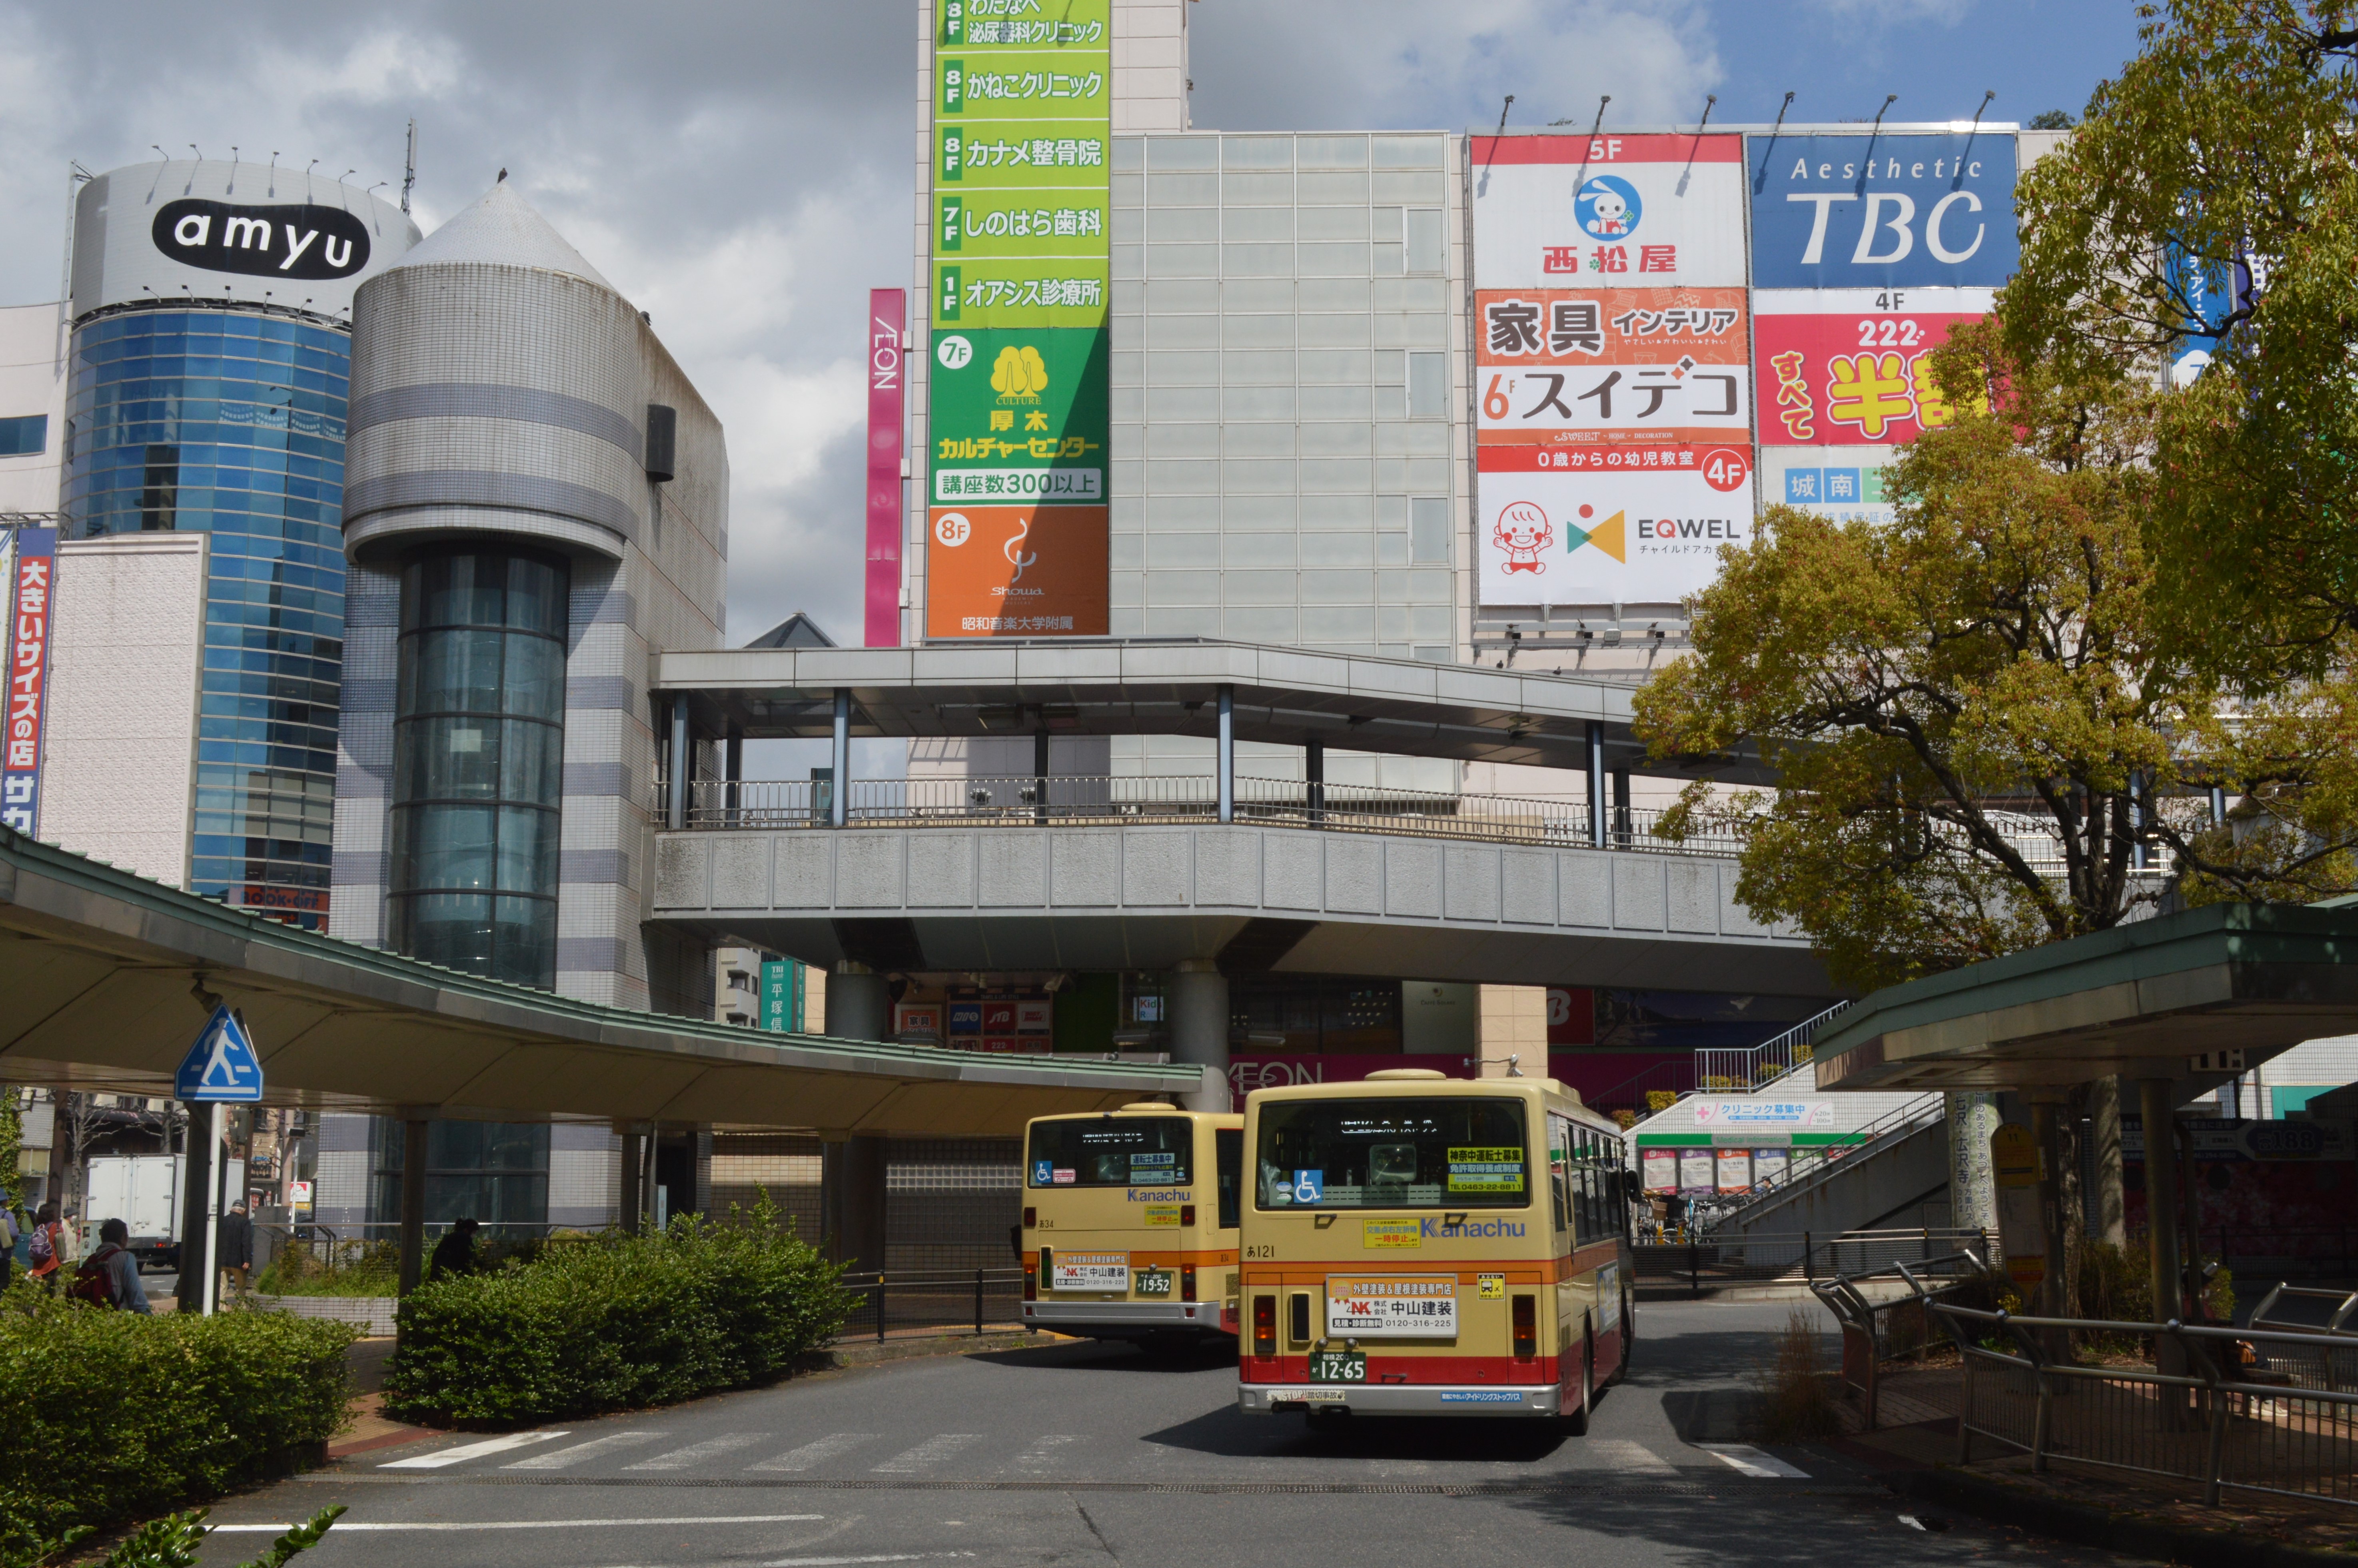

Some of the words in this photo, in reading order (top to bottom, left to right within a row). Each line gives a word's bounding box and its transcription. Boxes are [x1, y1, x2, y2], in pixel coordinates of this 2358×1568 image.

[968, 20, 1102, 44] 泌尿器科クリニック
[946, 70, 961, 103] 8F
[967, 72, 1102, 99] かねこクリニック
[945, 138, 960, 171] 8F
[966, 139, 1102, 167] カナメ整骨院
[1590, 140, 1622, 160] 5F
[1791, 156, 1981, 179] Aesthetic
[944, 208, 959, 240] 7F
[965, 209, 1102, 237] しのはら歯科
[1787, 191, 1985, 264] TBC
[174, 214, 352, 270] amyu
[1542, 245, 1676, 274] 西松屋
[944, 277, 957, 310] 1F
[964, 279, 1102, 307] オアシス診療所
[1875, 292, 1905, 311] 4F
[1489, 302, 1601, 353] 家具
[1613, 309, 1737, 334] インテリア
[944, 343, 967, 362] 7F
[996, 397, 1042, 405] CULTURE
[1483, 374, 1515, 420] 6F
[1522, 366, 1737, 419] スイデコ
[1772, 352, 1814, 438] すべて
[990, 410, 1048, 431] 厚木
[1555, 432, 1600, 441] SWEET
[939, 437, 1099, 459] カルチャーセンター
[1538, 451, 1694, 467] 0歳からの幼児教室
[1707, 458, 1741, 485] 4F
[942, 474, 1096, 495] 講座数300以上
[941, 520, 966, 540] 8F
[1639, 519, 1741, 539] EQWEL
[962, 616, 1073, 630] 昭和音楽大学附属
[9, 561, 47, 766] 大きいサイズの店
[908, 1015, 930, 1027] 家具
[988, 1011, 1010, 1024] JTB
[1721, 1105, 1805, 1114] クリニック募集中
[2272, 1130, 2316, 1151] 188
[1133, 1155, 1172, 1164] 運転士募集中
[1450, 1149, 1521, 1162] 神奈中運転士募集
[1450, 1164, 1520, 1173] 免許取得養成制度
[1128, 1188, 1190, 1202] Kanachu
[1978, 1152, 1989, 1220] あつへようこそ
[1040, 1220, 1054, 1228] あ34
[1421, 1218, 1525, 1238] Kanachu
[1246, 1245, 1275, 1259] あ121
[1090, 1267, 1125, 1277] 中山建装
[1143, 1279, 1169, 1291] 19-52
[1353, 1282, 1452, 1296] 外壁塗装&屋根塗装専門店
[1351, 1301, 1372, 1315] NK
[1391, 1300, 1452, 1316] 中山建装
[1322, 1361, 1364, 1378] 12-65
